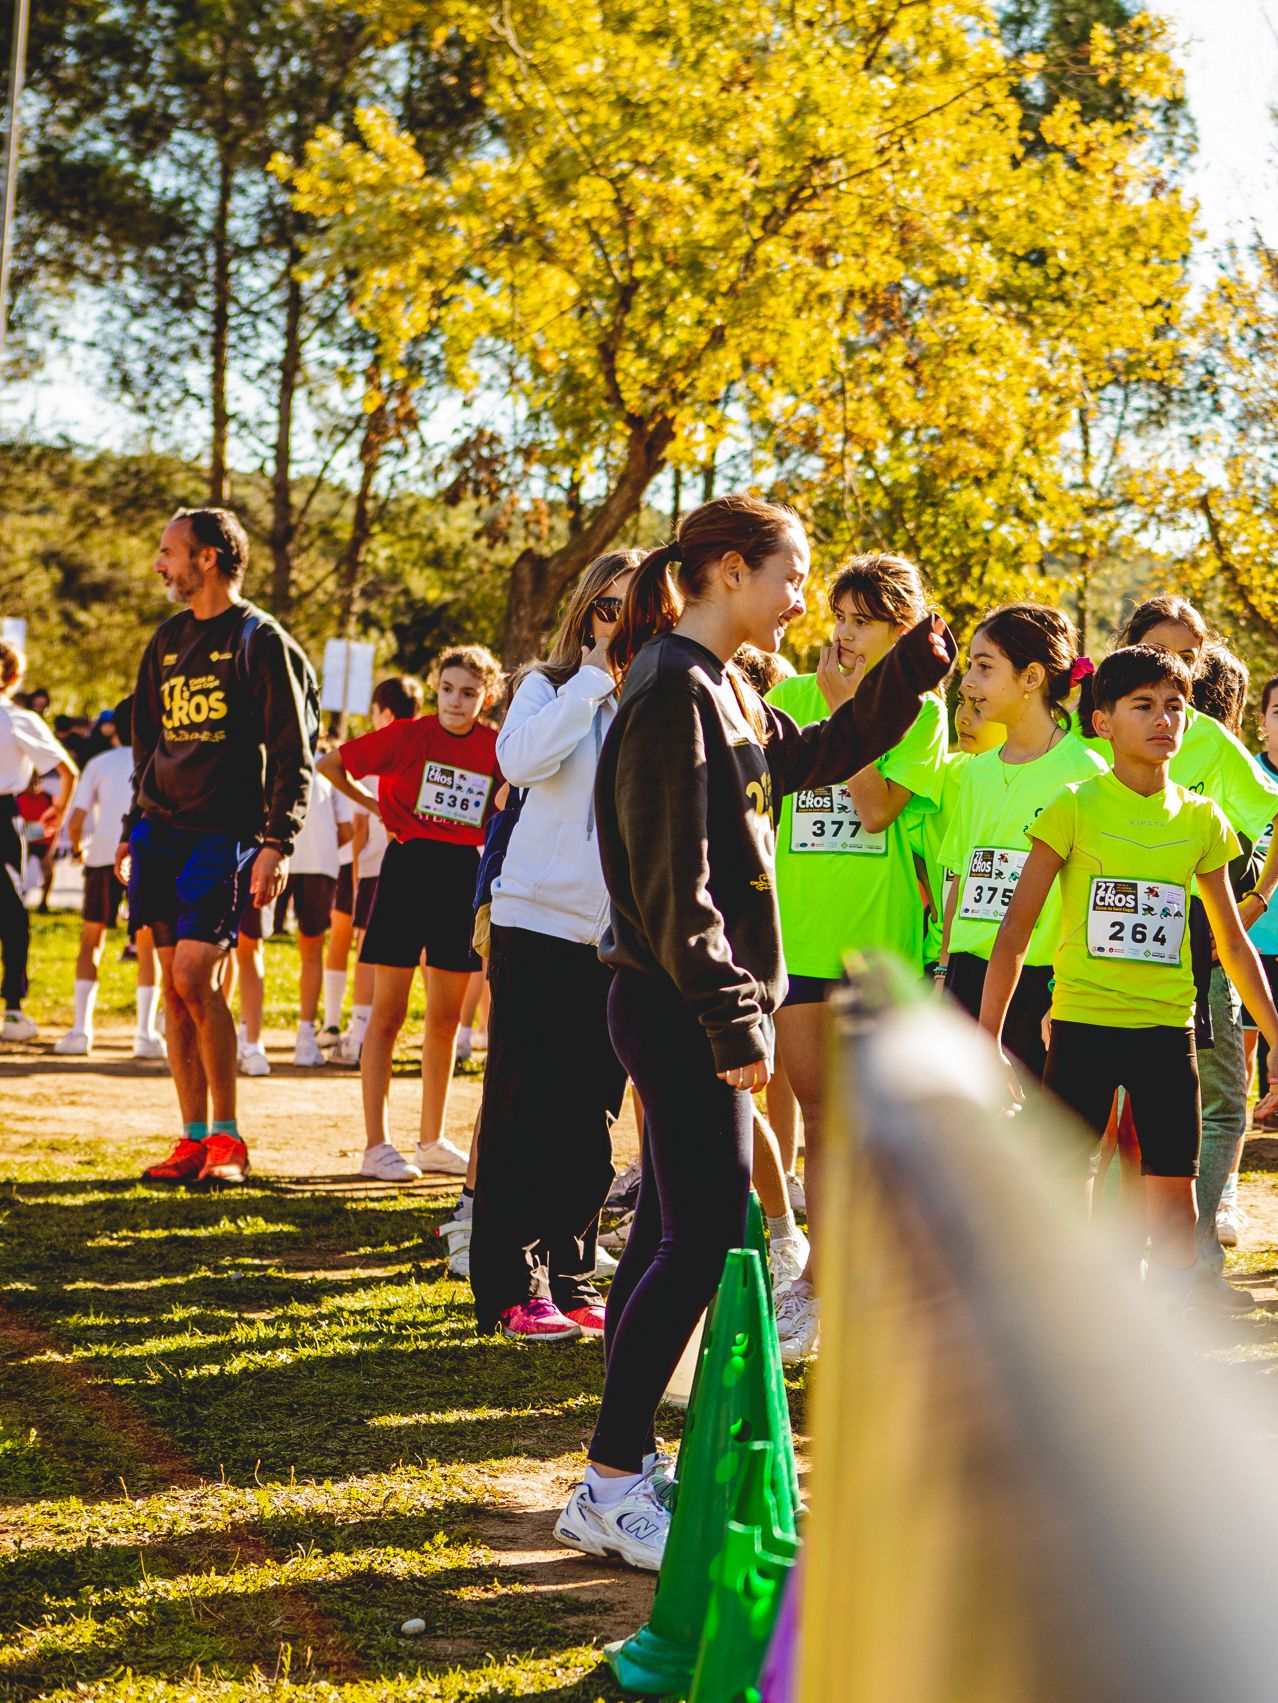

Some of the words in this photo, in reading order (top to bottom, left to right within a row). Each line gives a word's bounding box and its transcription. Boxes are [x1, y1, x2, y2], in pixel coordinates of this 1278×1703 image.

[428, 773, 453, 786] CROS
[434, 791, 470, 811] 536
[798, 797, 831, 809] CROS
[812, 820, 862, 838] 377
[1129, 819, 1165, 828] KIPSTA
[972, 861, 992, 873] CROS
[973, 885, 1014, 906] 375
[1095, 893, 1135, 908] CROS
[1108, 921, 1167, 946] 264
